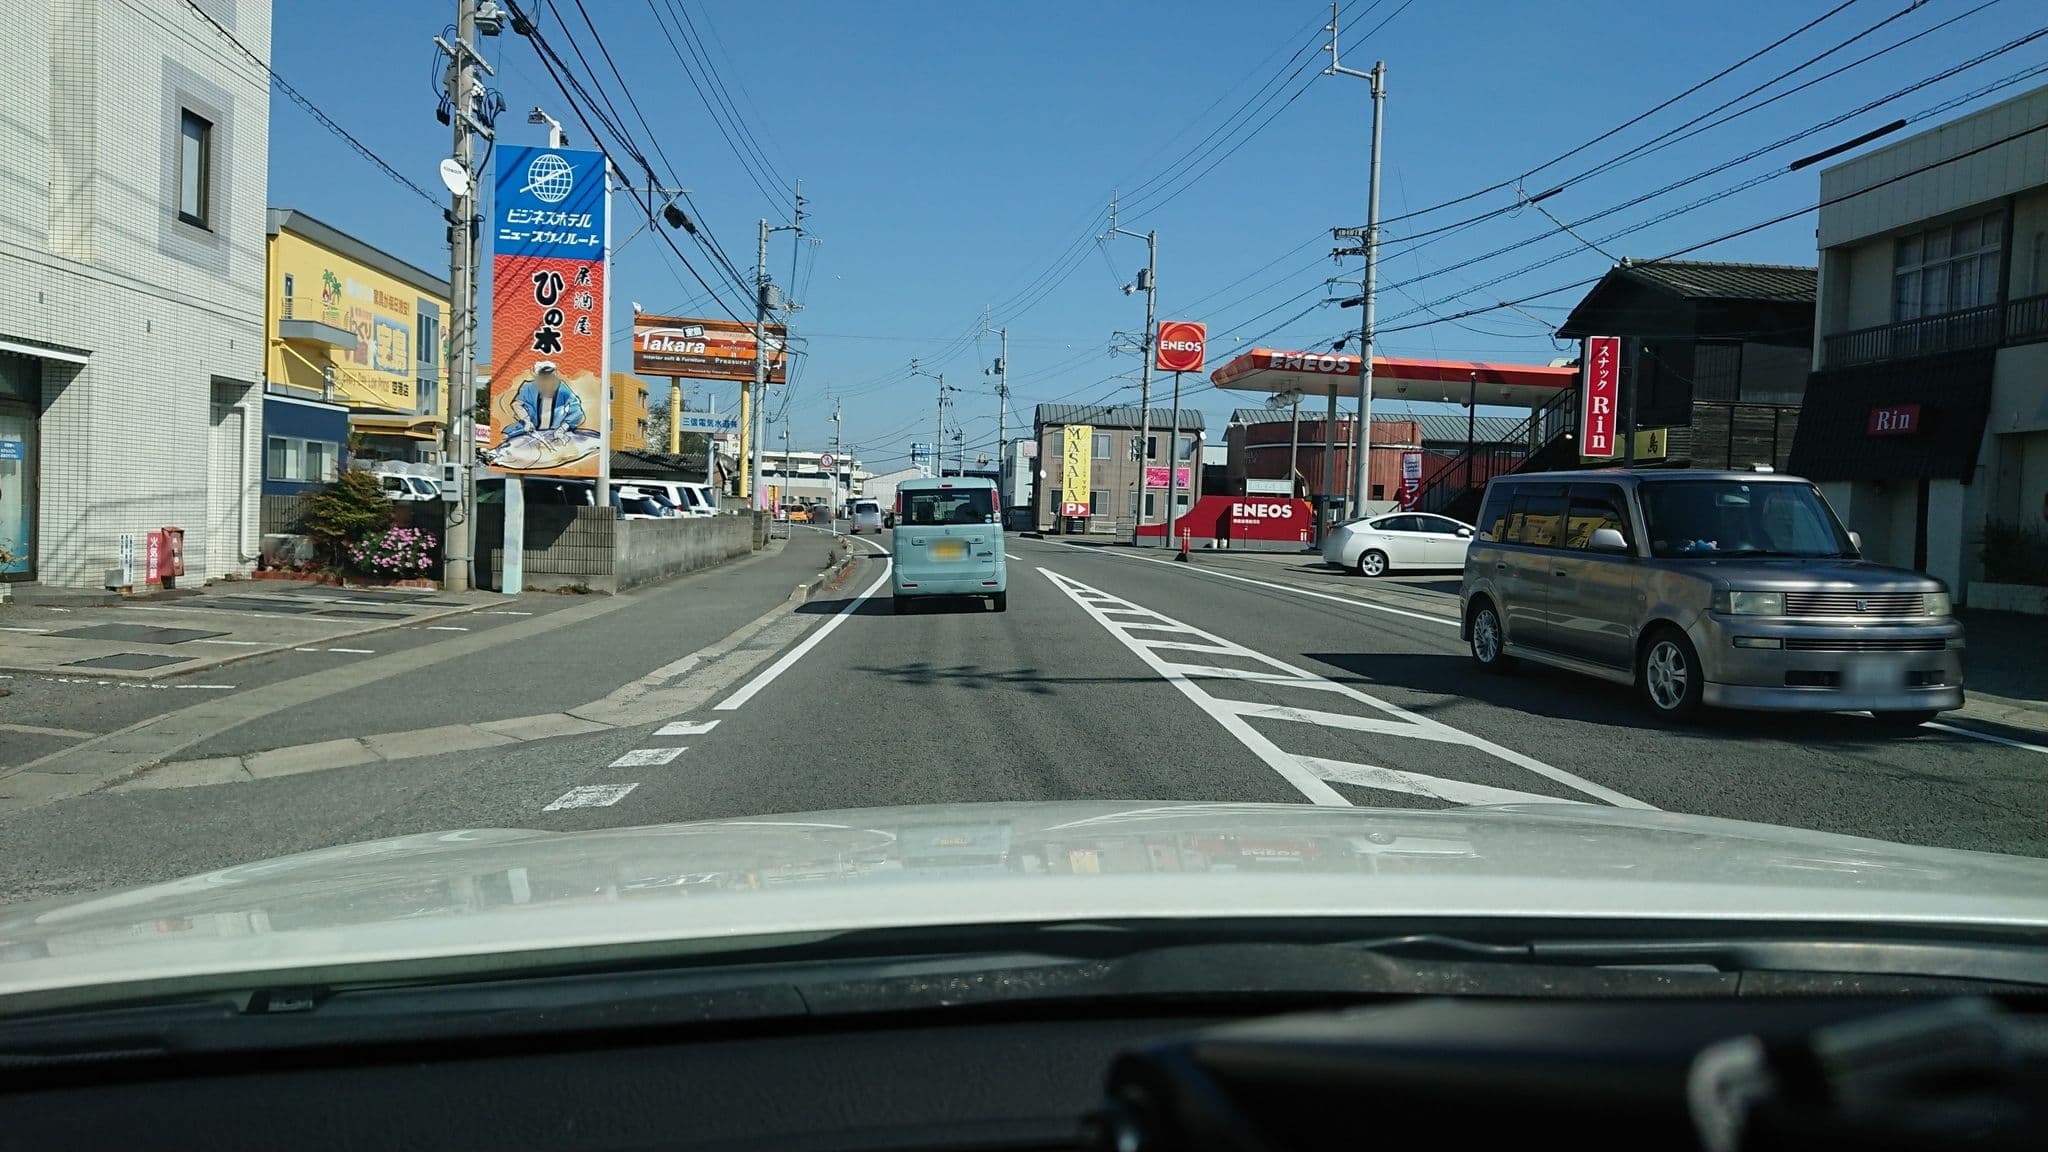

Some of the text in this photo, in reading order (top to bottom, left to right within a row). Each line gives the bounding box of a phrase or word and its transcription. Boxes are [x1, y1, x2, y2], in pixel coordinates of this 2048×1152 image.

[507, 209, 592, 228] ビジネスホテル
[532, 270, 564, 354] ひの木
[573, 266, 593, 335] 居酒屋
[639, 328, 706, 354] Takara
[1161, 340, 1202, 352] ENEOS
[1270, 352, 1350, 373] ENEOS
[1598, 346, 1609, 391] スナック
[1592, 396, 1610, 448] Rin
[1876, 410, 1910, 431] Rin
[1066, 427, 1081, 501] MASALA
[1066, 503, 1077, 514] P
[1232, 503, 1293, 519] ENEOS
